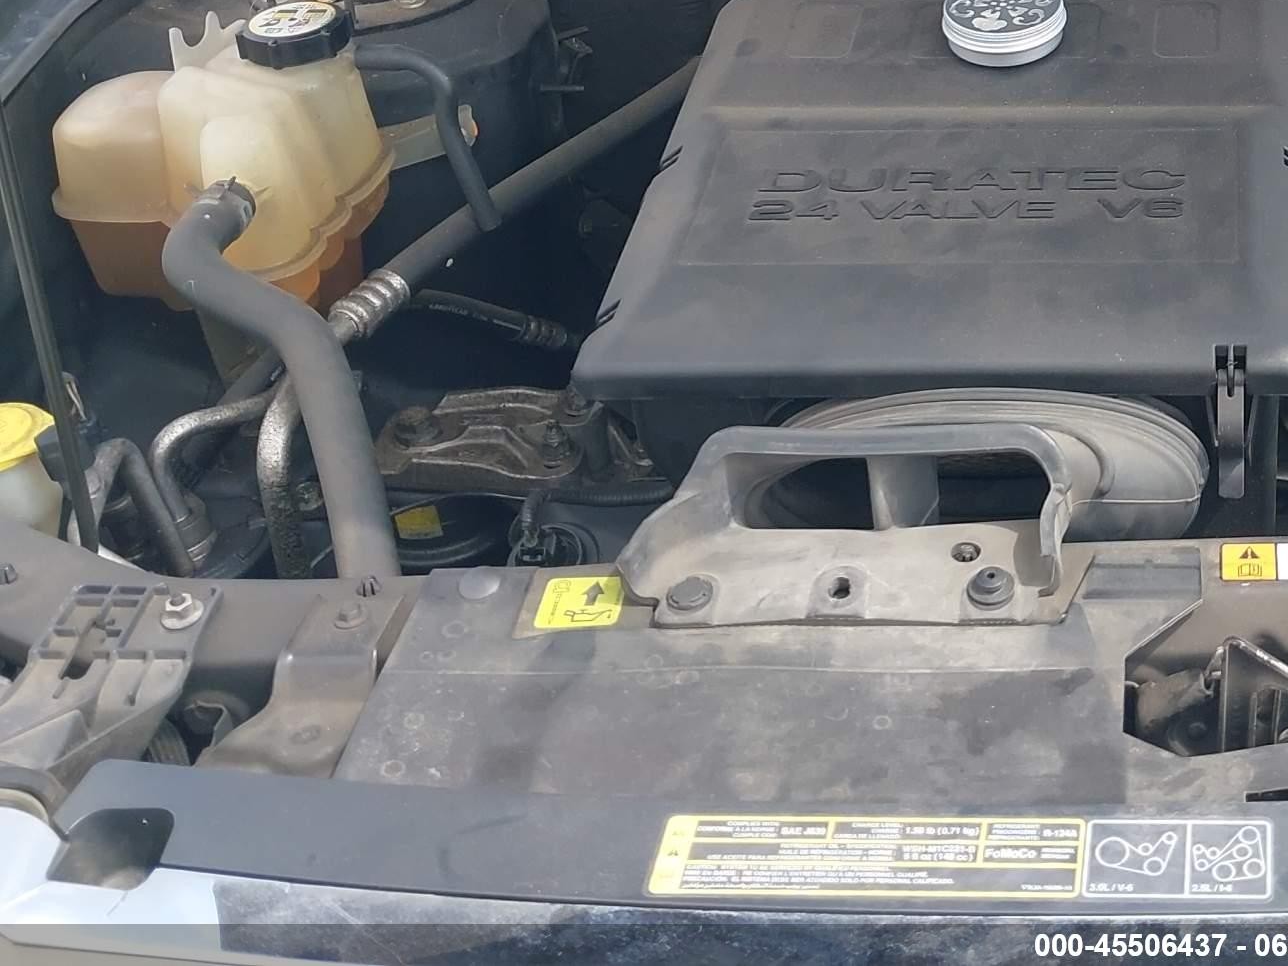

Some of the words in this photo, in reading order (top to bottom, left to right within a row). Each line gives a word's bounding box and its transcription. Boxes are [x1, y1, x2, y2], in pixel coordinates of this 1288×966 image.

[756, 167, 1186, 194] DURATEC
[747, 198, 839, 222] 24
[859, 198, 1059, 221] VALVE
[1096, 197, 1185, 220] V6
[984, 848, 1038, 859] FoMoCo
